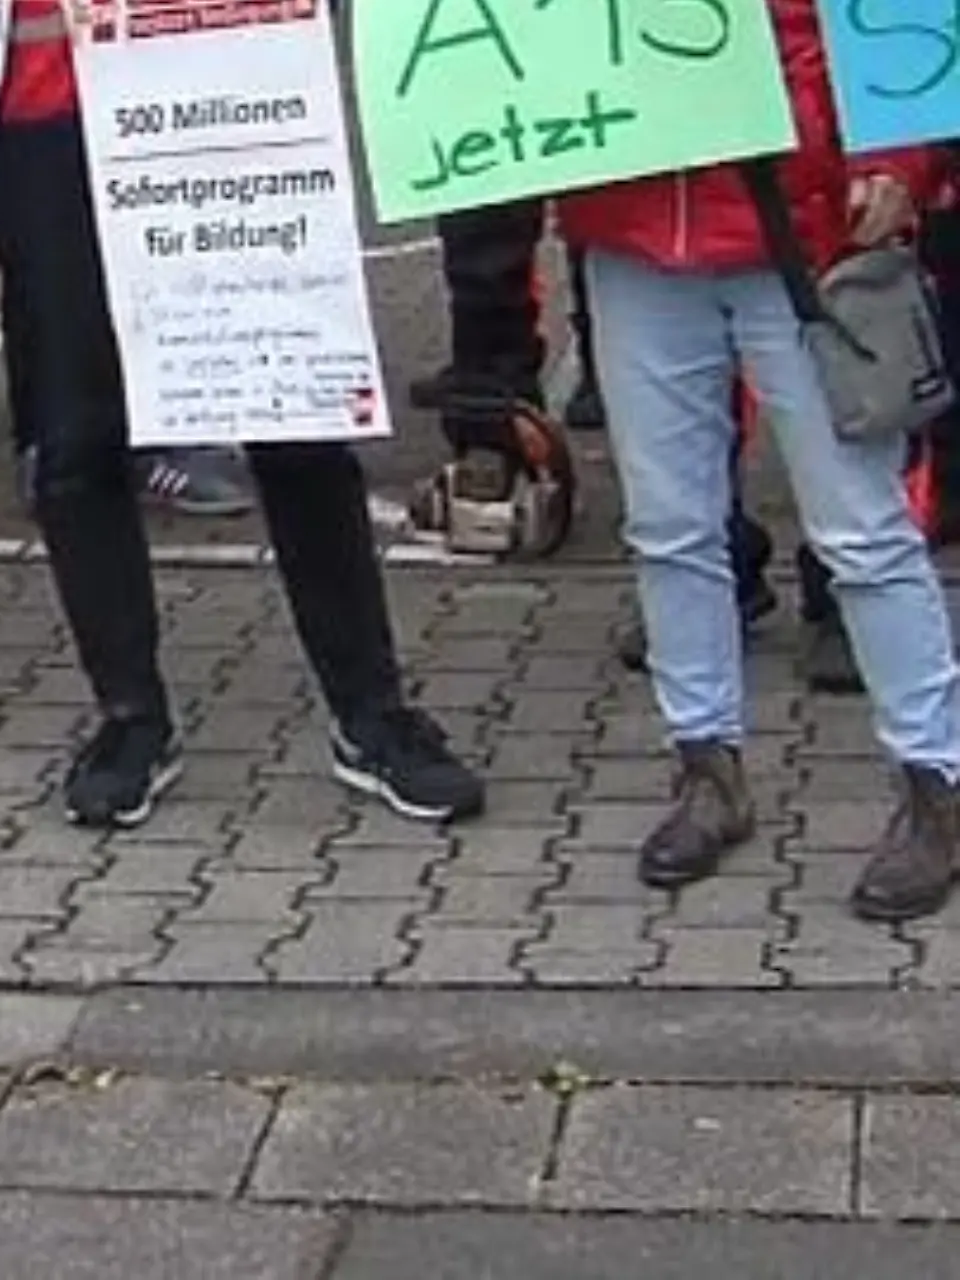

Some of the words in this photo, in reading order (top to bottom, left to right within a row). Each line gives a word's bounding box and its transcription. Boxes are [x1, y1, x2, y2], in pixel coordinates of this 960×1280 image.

[114, 103, 164, 138] 500
[172, 94, 307, 130] Millionen
[411, 90, 636, 190] jetzt
[106, 167, 337, 210] Sofortprogramm
[145, 224, 185, 258] für
[194, 213, 306, 256] Bildung!
